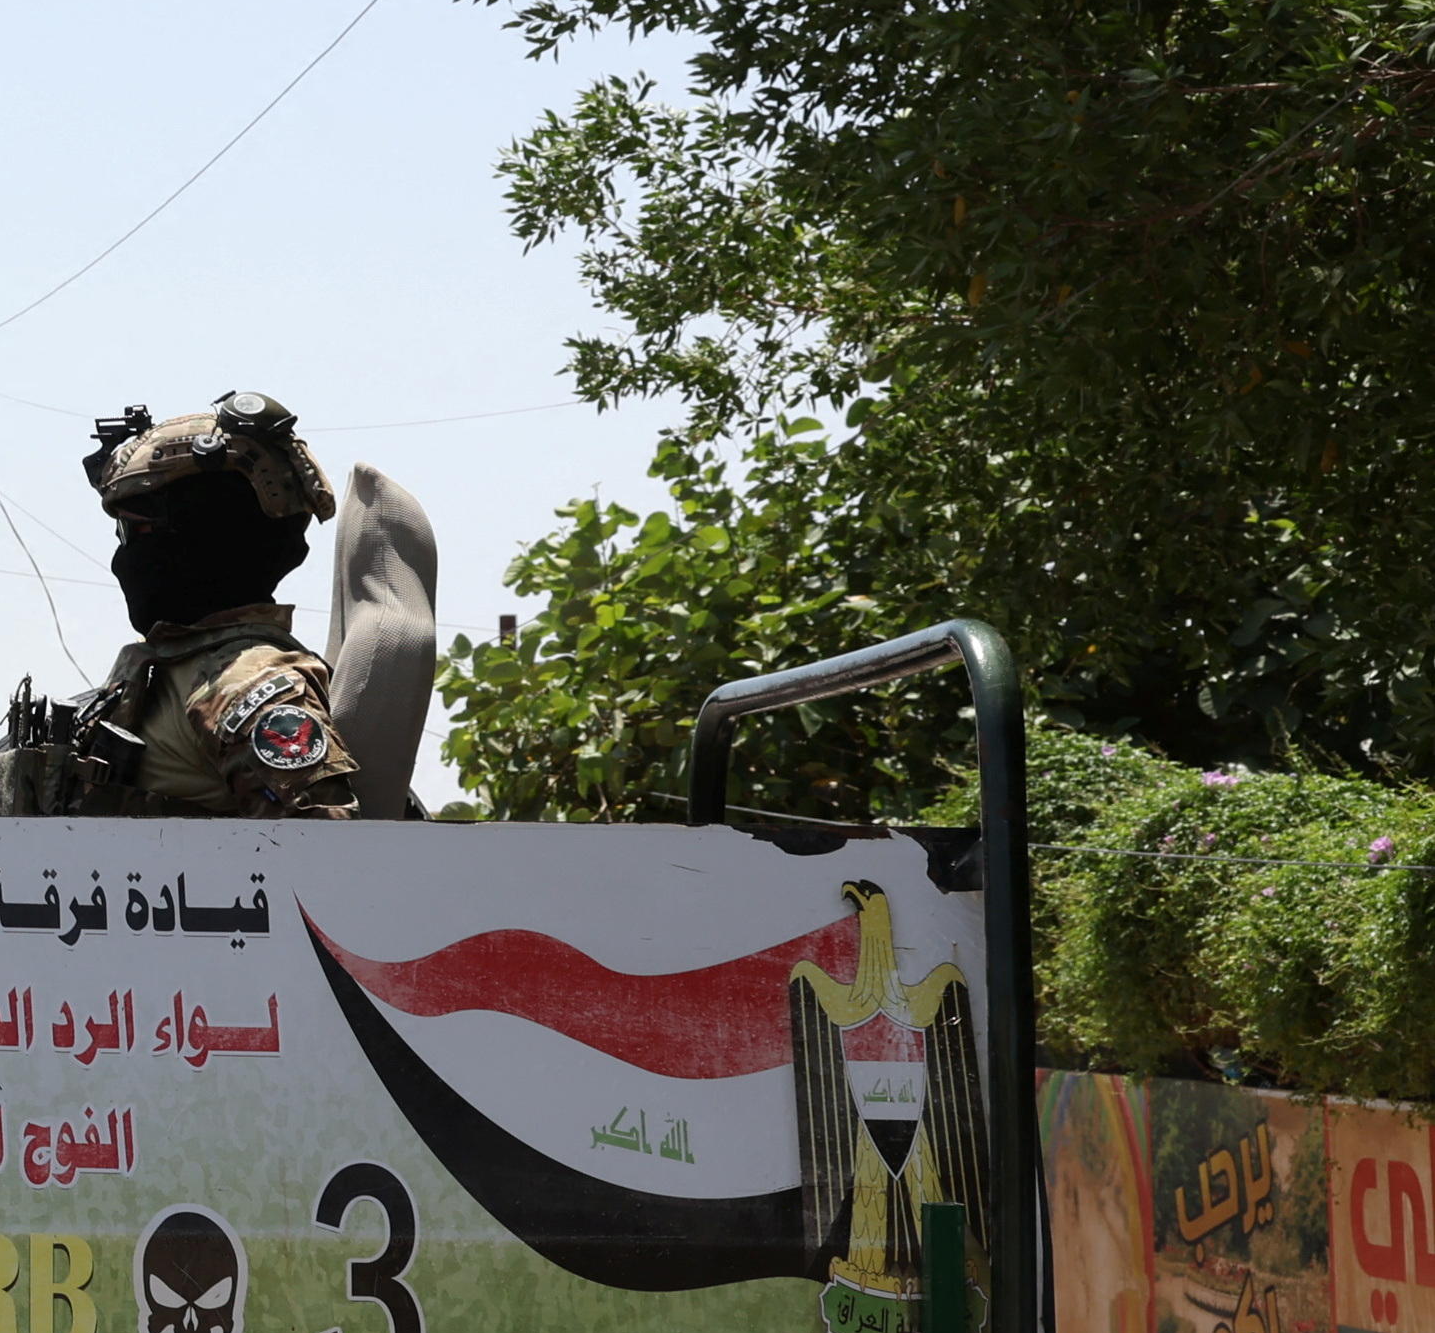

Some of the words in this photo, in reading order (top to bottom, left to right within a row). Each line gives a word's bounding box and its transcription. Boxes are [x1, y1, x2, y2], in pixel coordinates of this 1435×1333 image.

[235, 682, 276, 718] E.R.D
[125, 871, 270, 950] قيادة
[50, 987, 134, 1064] الرد
[152, 988, 280, 1068] لواء
[22, 1106, 134, 1186] الفوج
[1174, 1119, 1275, 1267] يرحب
